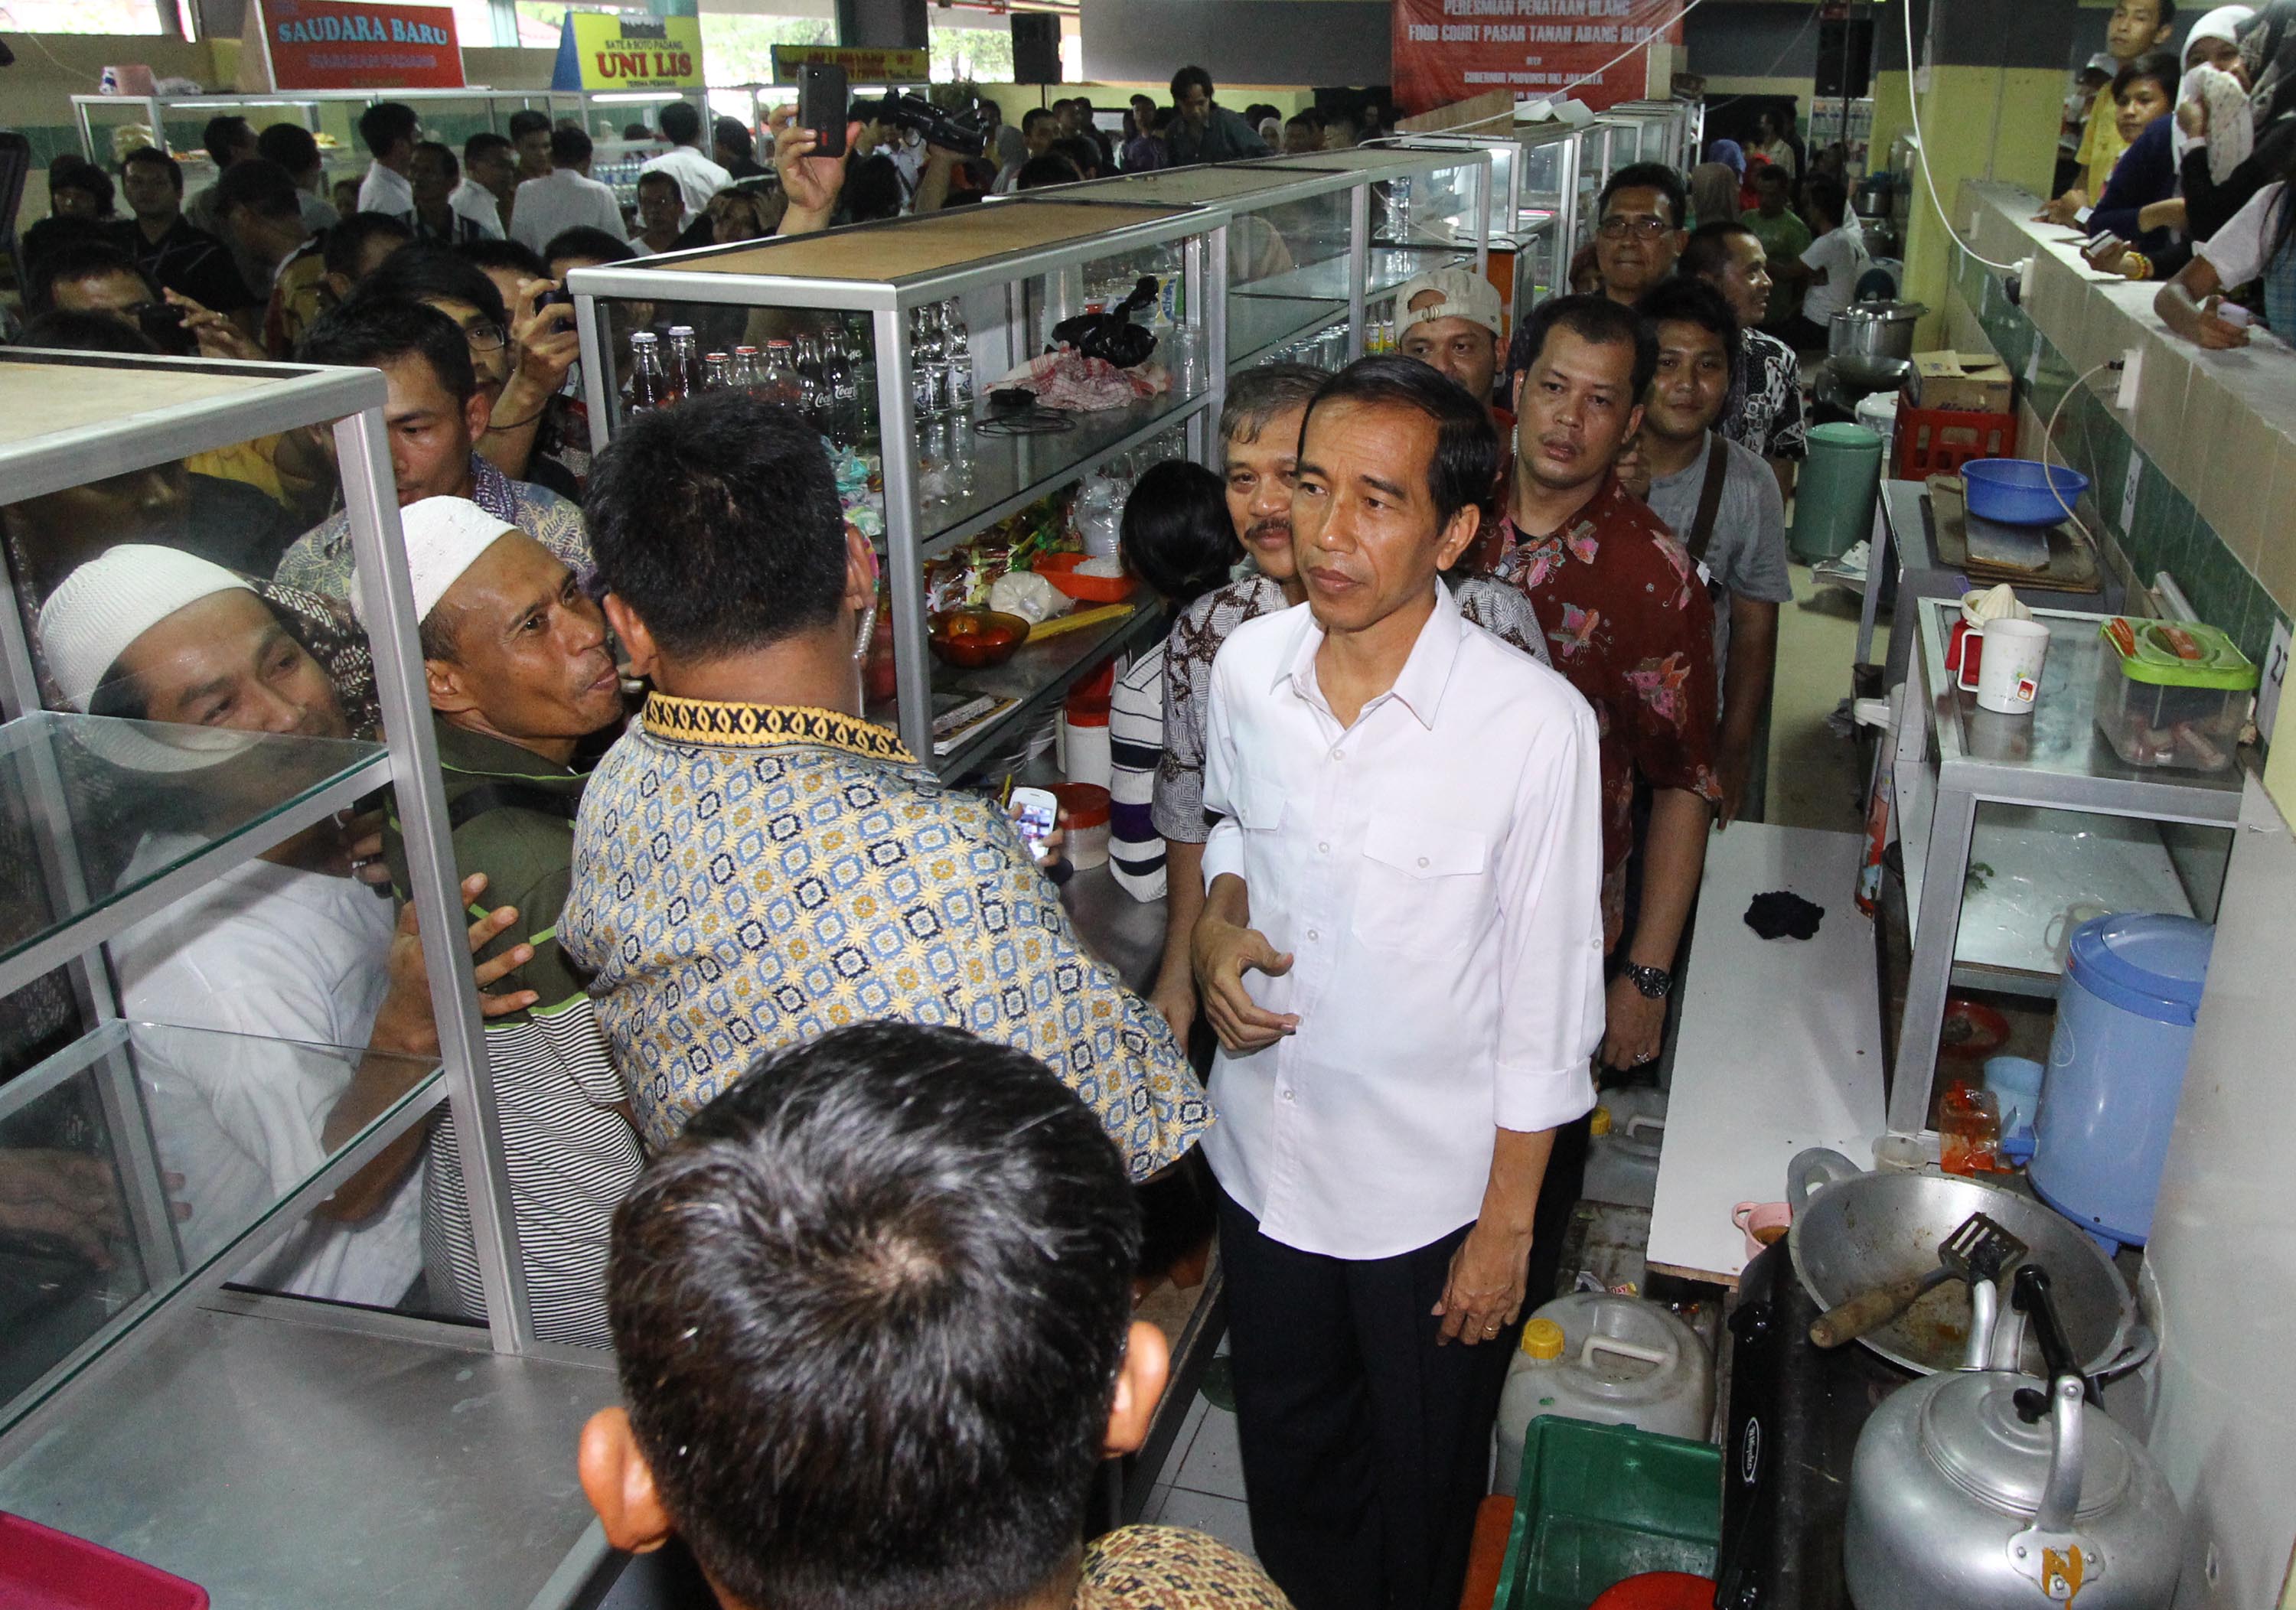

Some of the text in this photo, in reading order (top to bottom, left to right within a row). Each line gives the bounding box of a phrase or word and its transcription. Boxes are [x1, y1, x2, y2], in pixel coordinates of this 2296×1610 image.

[278, 15, 447, 45] SAUDARA BARU
[1408, 24, 1439, 41] FOOD
[1441, 24, 1480, 41] COURT
[1483, 25, 1526, 41] PASAR
[1529, 25, 1572, 42] TANAH
[1575, 26, 1618, 43] ABANG
[595, 51, 693, 78] UNI LIS
